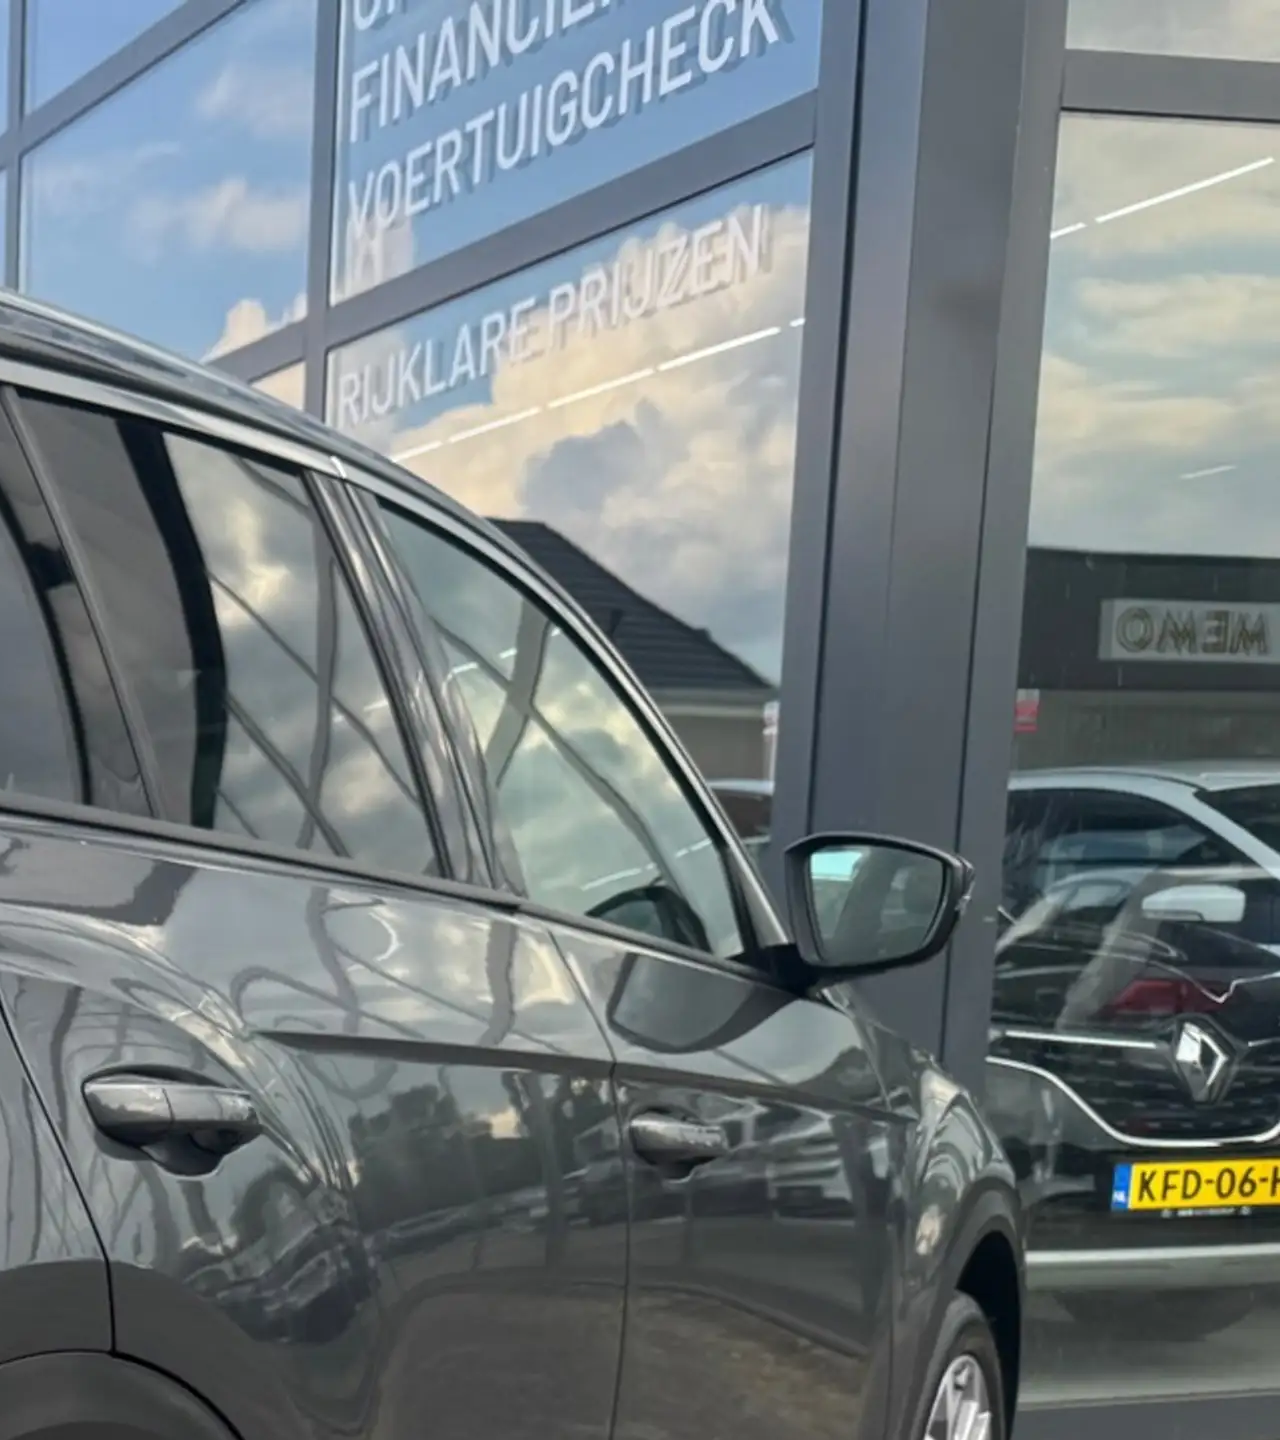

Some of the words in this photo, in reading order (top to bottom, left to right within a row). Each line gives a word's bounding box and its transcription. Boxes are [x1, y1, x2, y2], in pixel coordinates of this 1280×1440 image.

[349, 0, 779, 238] VOERTUIGCHECK
[339, 297, 536, 430] RIJKLARE
[547, 204, 762, 350] PRIJZEN
